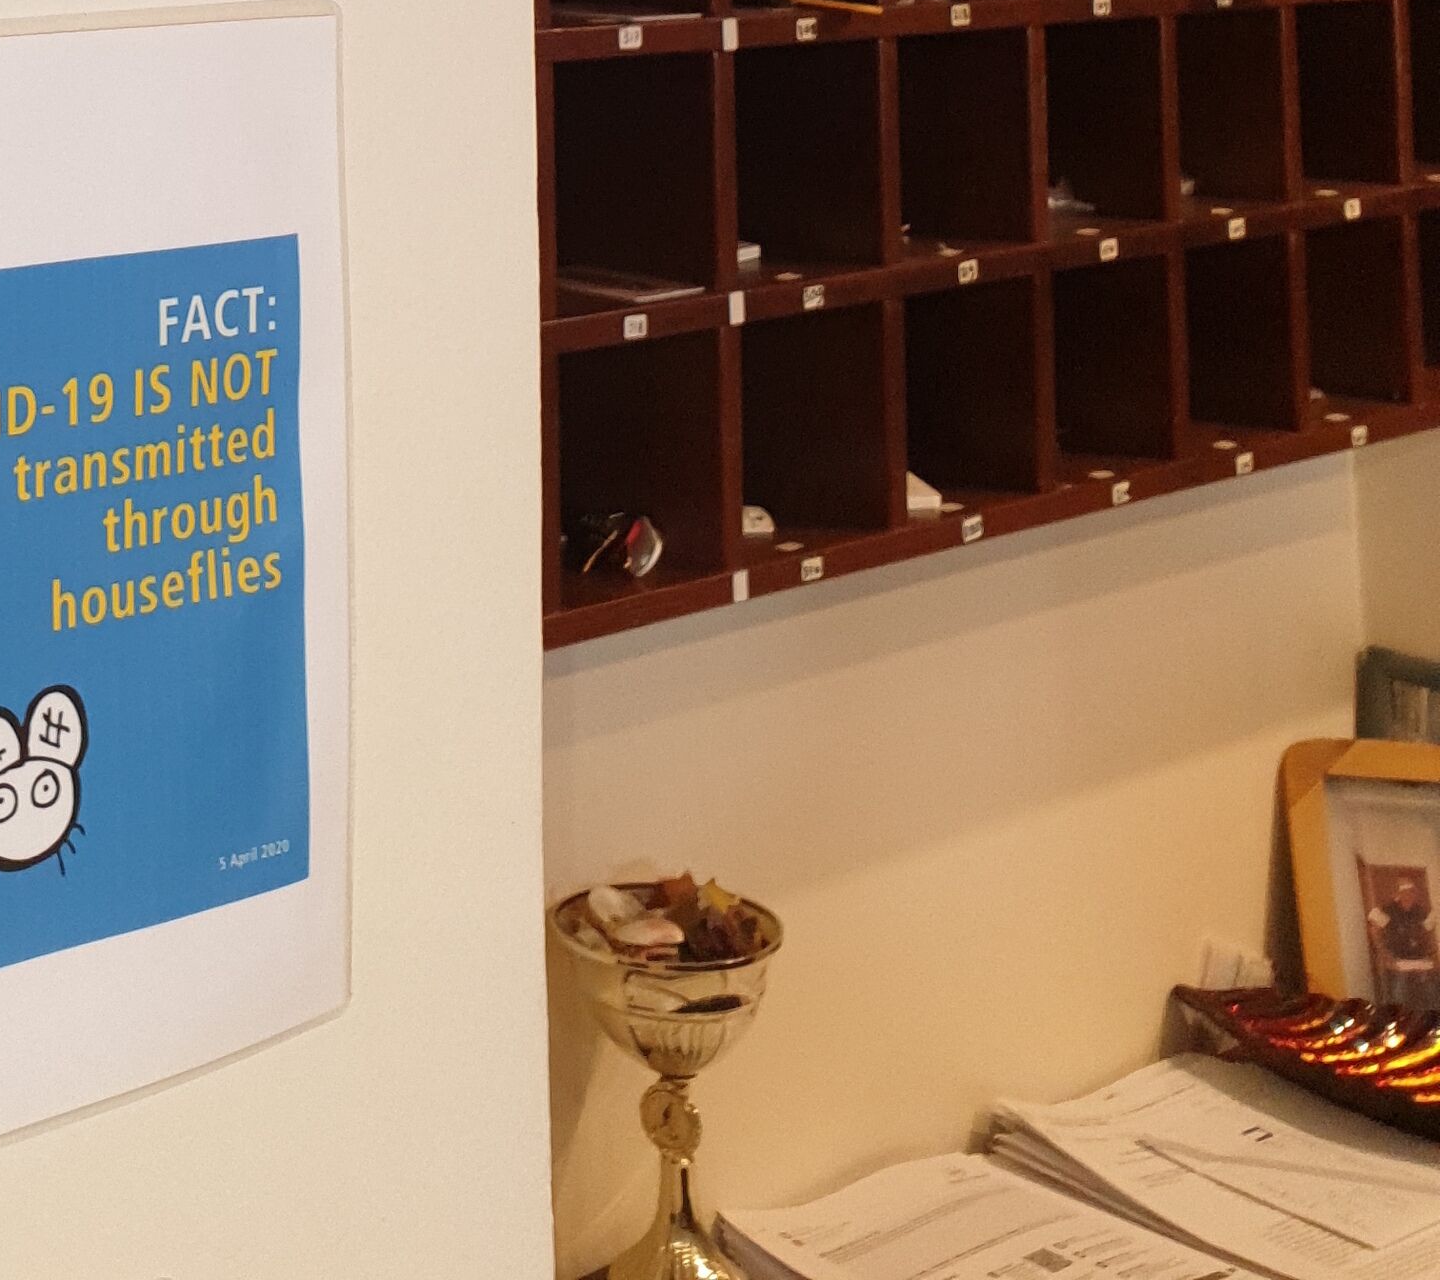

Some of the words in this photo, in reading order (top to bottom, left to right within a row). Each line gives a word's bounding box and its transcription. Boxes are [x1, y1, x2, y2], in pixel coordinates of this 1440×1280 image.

[159, 287, 275, 346] FACT:
[135, 365, 171, 416] IS
[191, 349, 277, 407] NOT
[13, 408, 274, 502] transmitted
[103, 475, 276, 553] through
[52, 547, 281, 631] houseflies
